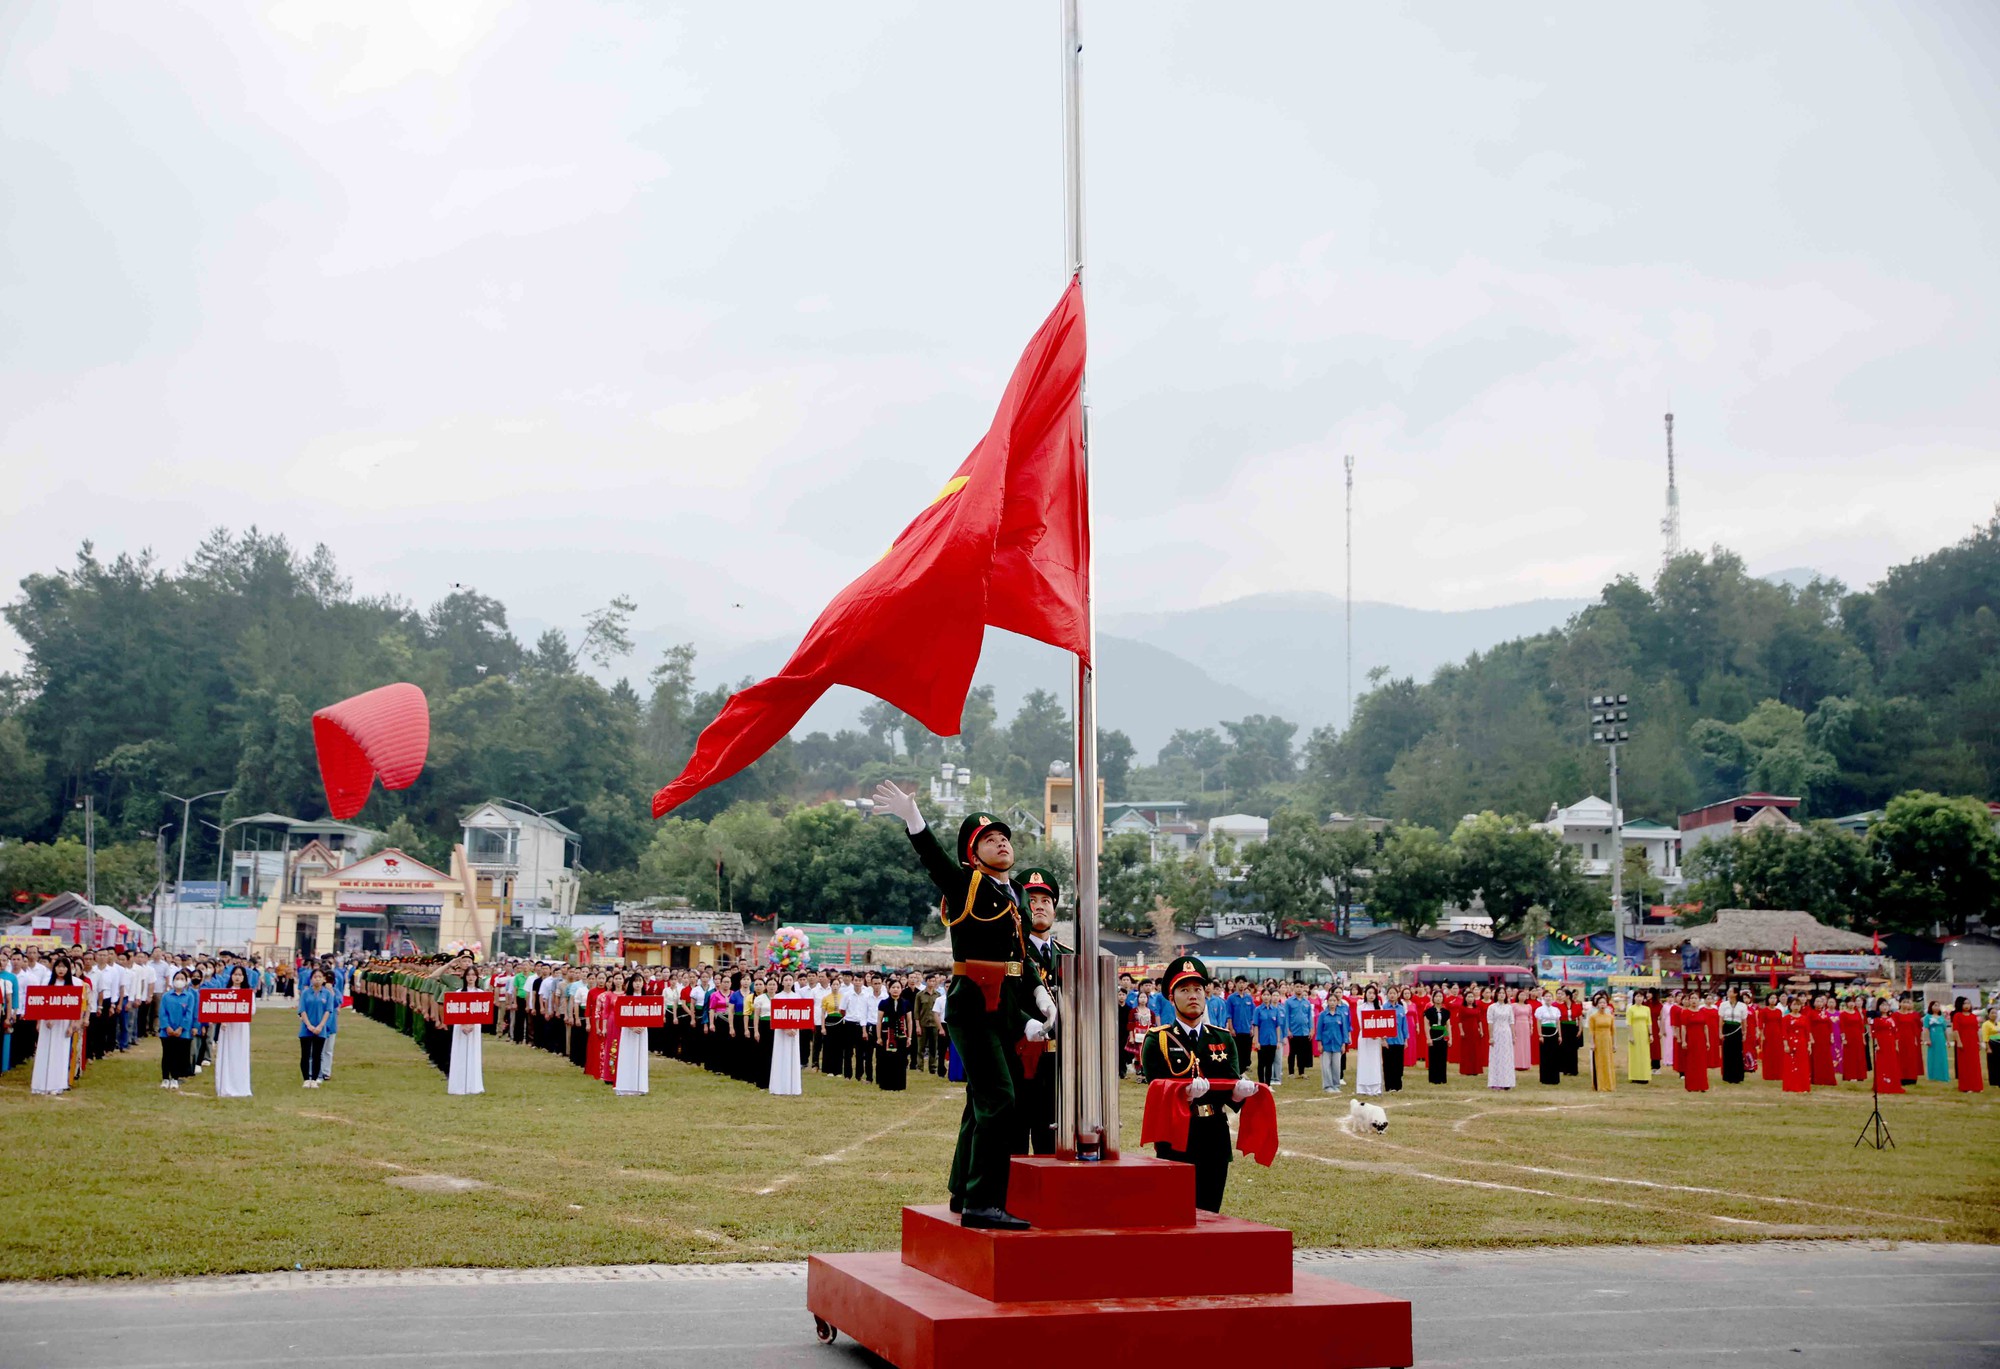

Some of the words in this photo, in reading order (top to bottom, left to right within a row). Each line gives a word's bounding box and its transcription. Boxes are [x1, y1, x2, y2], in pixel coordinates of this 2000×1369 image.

[49, 995, 62, 1006] LAO
[62, 993, 79, 1008] ĐỘNG
[210, 990, 238, 1000] KHỐI
[202, 999, 218, 1014] ĐOÀN
[218, 1001, 236, 1014] THANH
[236, 999, 250, 1014] NIÊN
[446, 999, 460, 1014] CÔNG
[459, 1002, 467, 1014] AN
[469, 999, 483, 1015] QUÂN
[483, 1000, 491, 1016] SỰ
[620, 1000, 634, 1017] KHỐI
[633, 1002, 649, 1017] NÔNG
[649, 1002, 662, 1017] DÂN
[773, 1005, 788, 1020] KHỐI
[788, 1009, 801, 1023] PHỤ
[801, 1006, 811, 1020] NỮ
[1363, 1014, 1376, 1029] KHỐI
